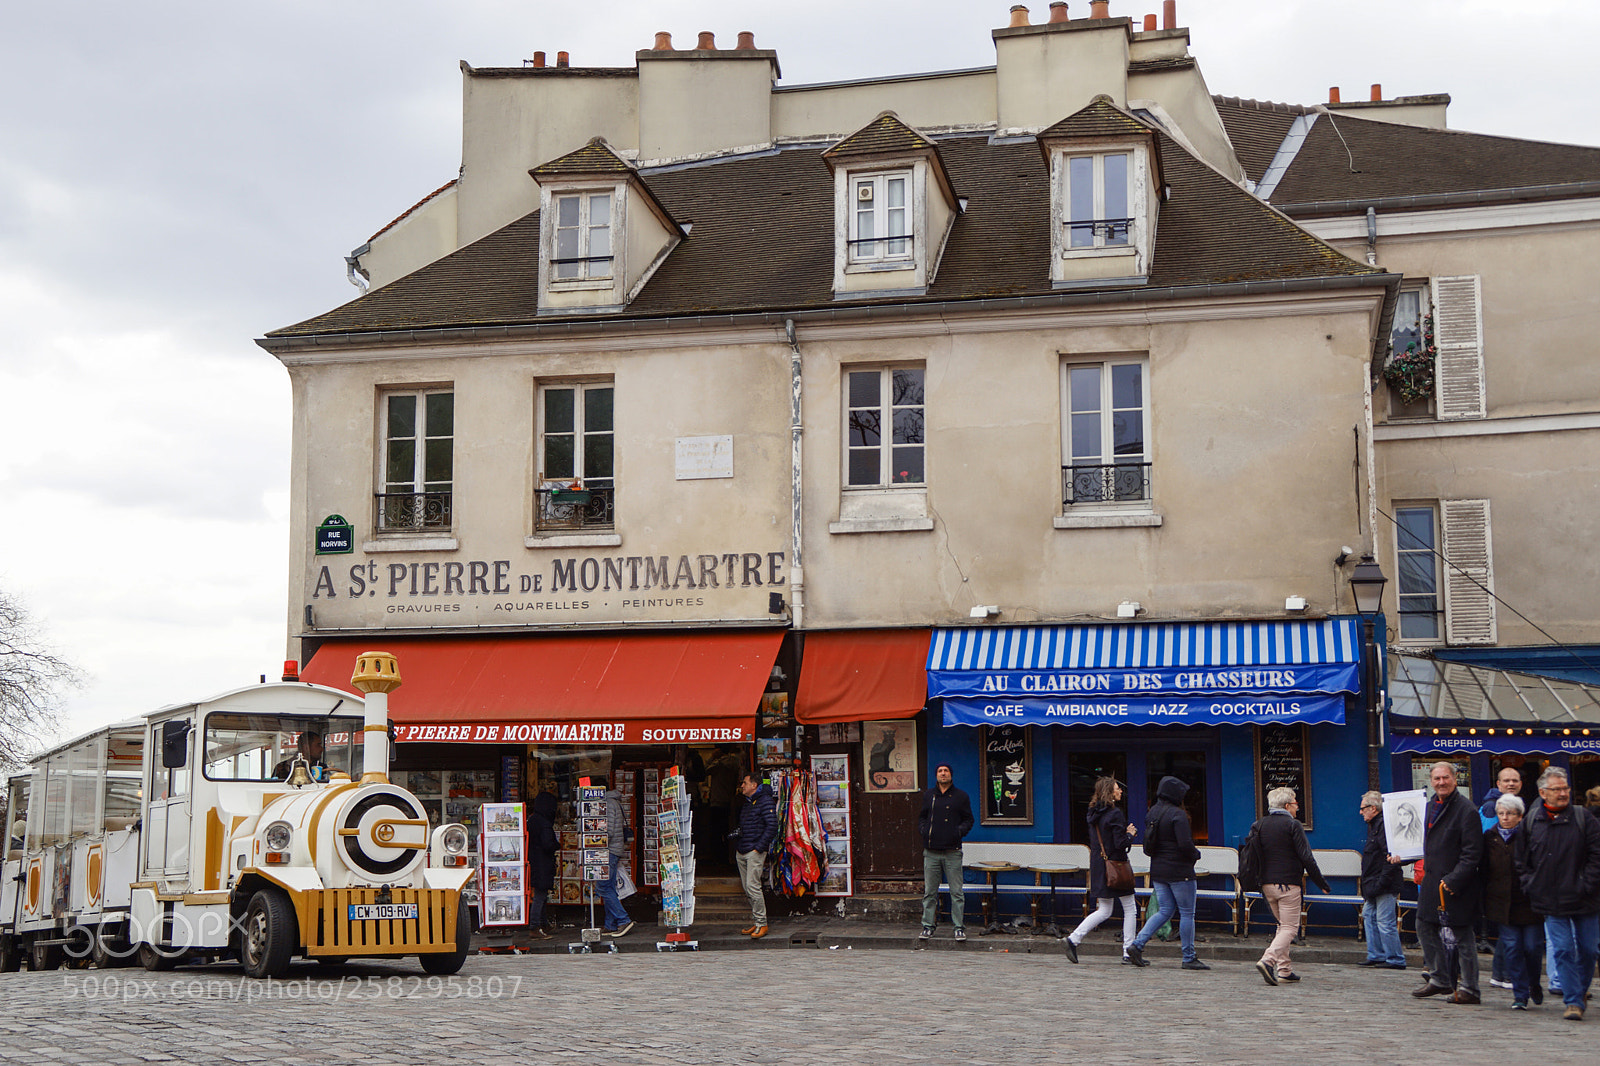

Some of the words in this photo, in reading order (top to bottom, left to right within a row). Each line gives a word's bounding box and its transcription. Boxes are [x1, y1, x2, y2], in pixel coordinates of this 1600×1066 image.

[320, 540, 348, 548] NORVINS
[312, 565, 336, 597] A
[386, 560, 510, 596] PIERRE
[519, 574, 542, 592] DE
[550, 551, 785, 592] MONTMARTRE
[386, 604, 461, 614] GRAVURES
[493, 601, 590, 611] AQUARELLES
[622, 597, 704, 608] PEINTURES
[982, 675, 1009, 692] AU
[1020, 674, 1111, 692] CLAIRON
[1123, 673, 1163, 690] DES
[1174, 670, 1296, 690] CHASSEURS
[983, 705, 1024, 716] CAFE
[1045, 704, 1129, 716] AMBIANCE
[1148, 704, 1188, 716] JAZZ
[1209, 703, 1301, 716] COCKTAILS
[406, 726, 471, 741] PIERRE
[473, 726, 500, 741] DE
[502, 723, 625, 742] MONTMARTRE
[642, 727, 742, 741] SOUVENIRS
[1433, 739, 1483, 748] CREPERIE
[1560, 740, 1600, 748] GLACES
